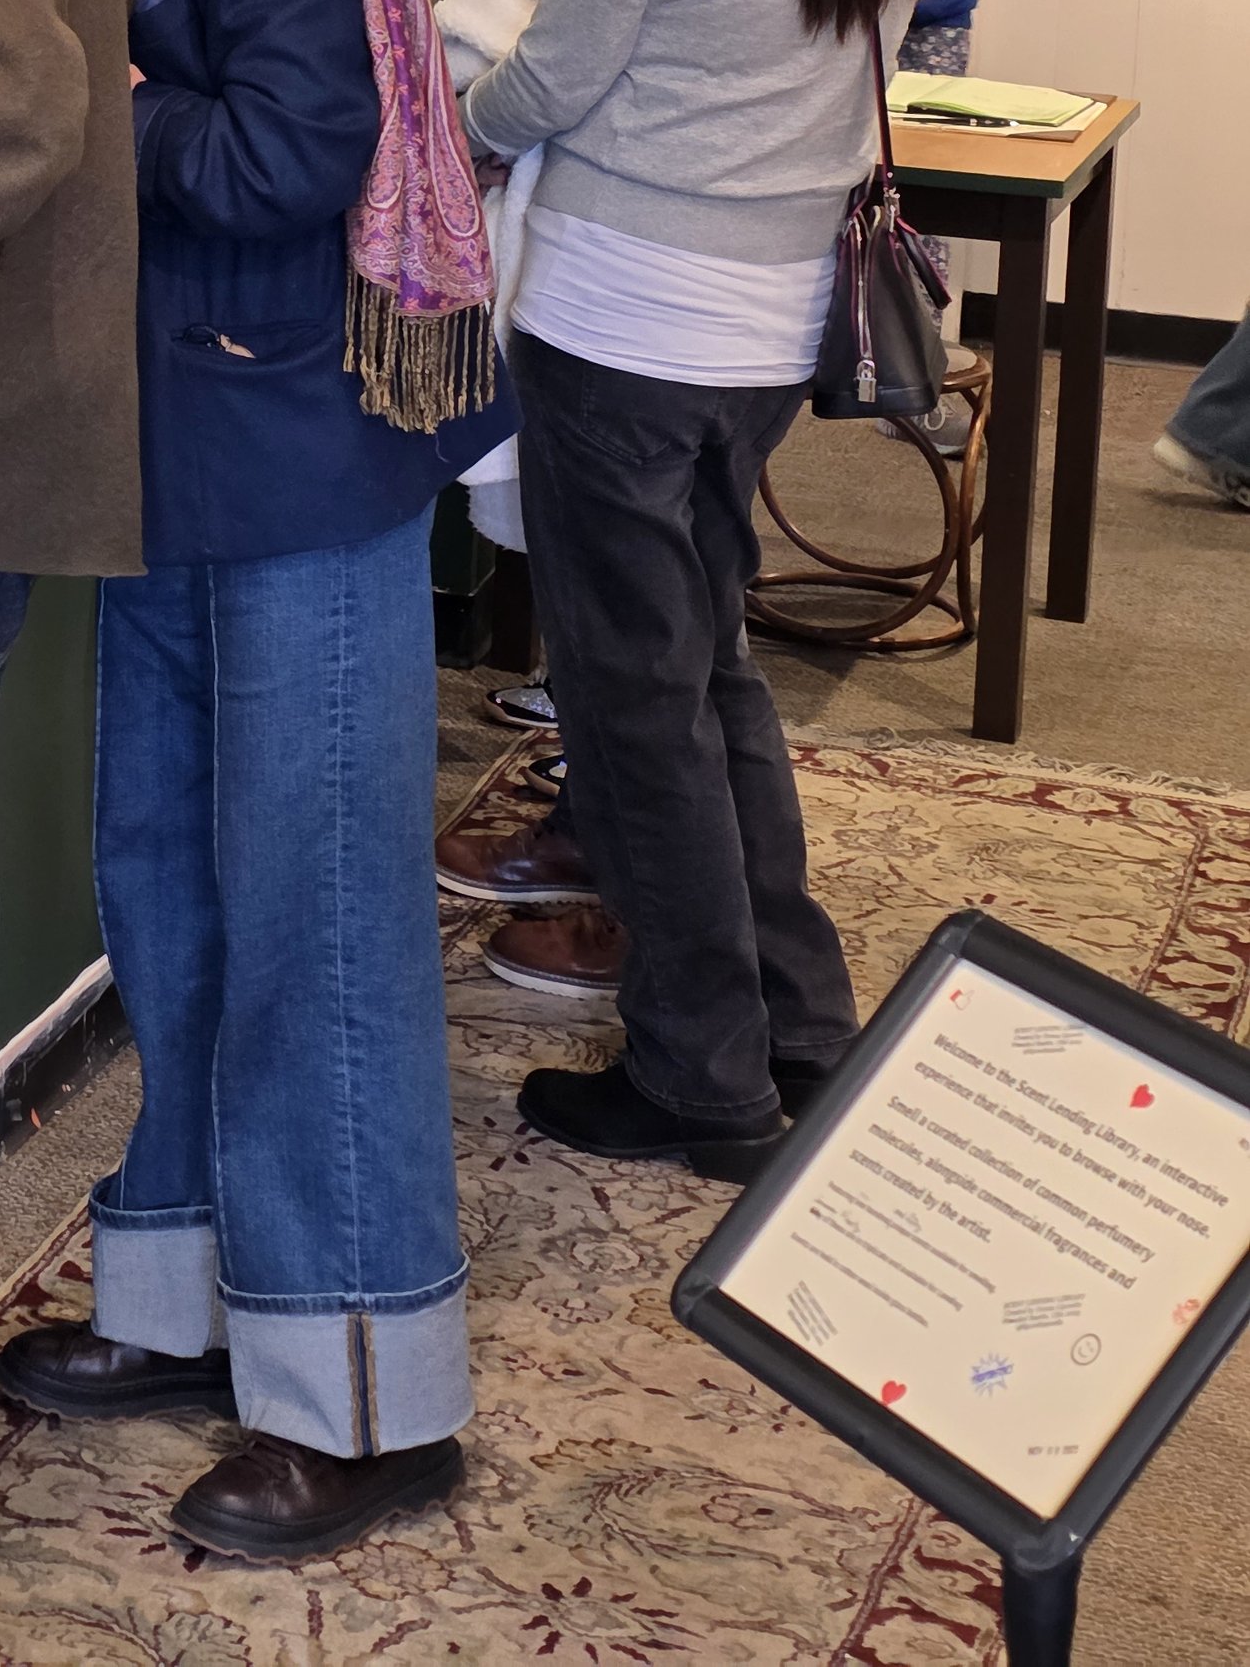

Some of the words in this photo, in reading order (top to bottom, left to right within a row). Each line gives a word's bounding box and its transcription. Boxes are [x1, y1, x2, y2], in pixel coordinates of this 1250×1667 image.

[845, 1147, 885, 1176] scents
[881, 1167, 926, 1200] created
[920, 1190, 941, 1212] by
[937, 1199, 961, 1221] the
[955, 1212, 996, 1243] artist.
[865, 1121, 927, 1165] molecules,
[922, 1153, 981, 1197] alongside
[975, 1185, 1049, 1236] commercial
[1040, 1225, 1111, 1276] fragrances
[1106, 1264, 1136, 1290] and
[886, 1094, 922, 1122] Smell
[917, 1115, 928, 1128] a
[925, 1119, 970, 1151] curated
[966, 1141, 1025, 1183] collection
[1022, 1173, 1040, 1192] of
[1034, 1184, 1089, 1222] common
[1083, 1212, 1157, 1265] perfumery
[912, 1058, 975, 1103] experience
[972, 1092, 1000, 1115] that
[996, 1104, 1038, 1136] invites
[1033, 1129, 1060, 1153] you
[1057, 1141, 1074, 1158] to
[1071, 1147, 1119, 1183] browse
[1116, 1174, 1148, 1200] with
[1143, 1191, 1178, 1221] your
[1175, 1209, 1214, 1239] nose.
[933, 1033, 984, 1069] Welcome
[982, 1061, 998, 1077] to
[995, 1069, 1017, 1088] the
[1015, 1079, 1050, 1106] Scent
[1045, 1097, 1096, 1135] Lending
[1092, 1123, 1144, 1162] Library,
[1141, 1151, 1160, 1169] an
[1158, 1160, 1230, 1208] interactive
